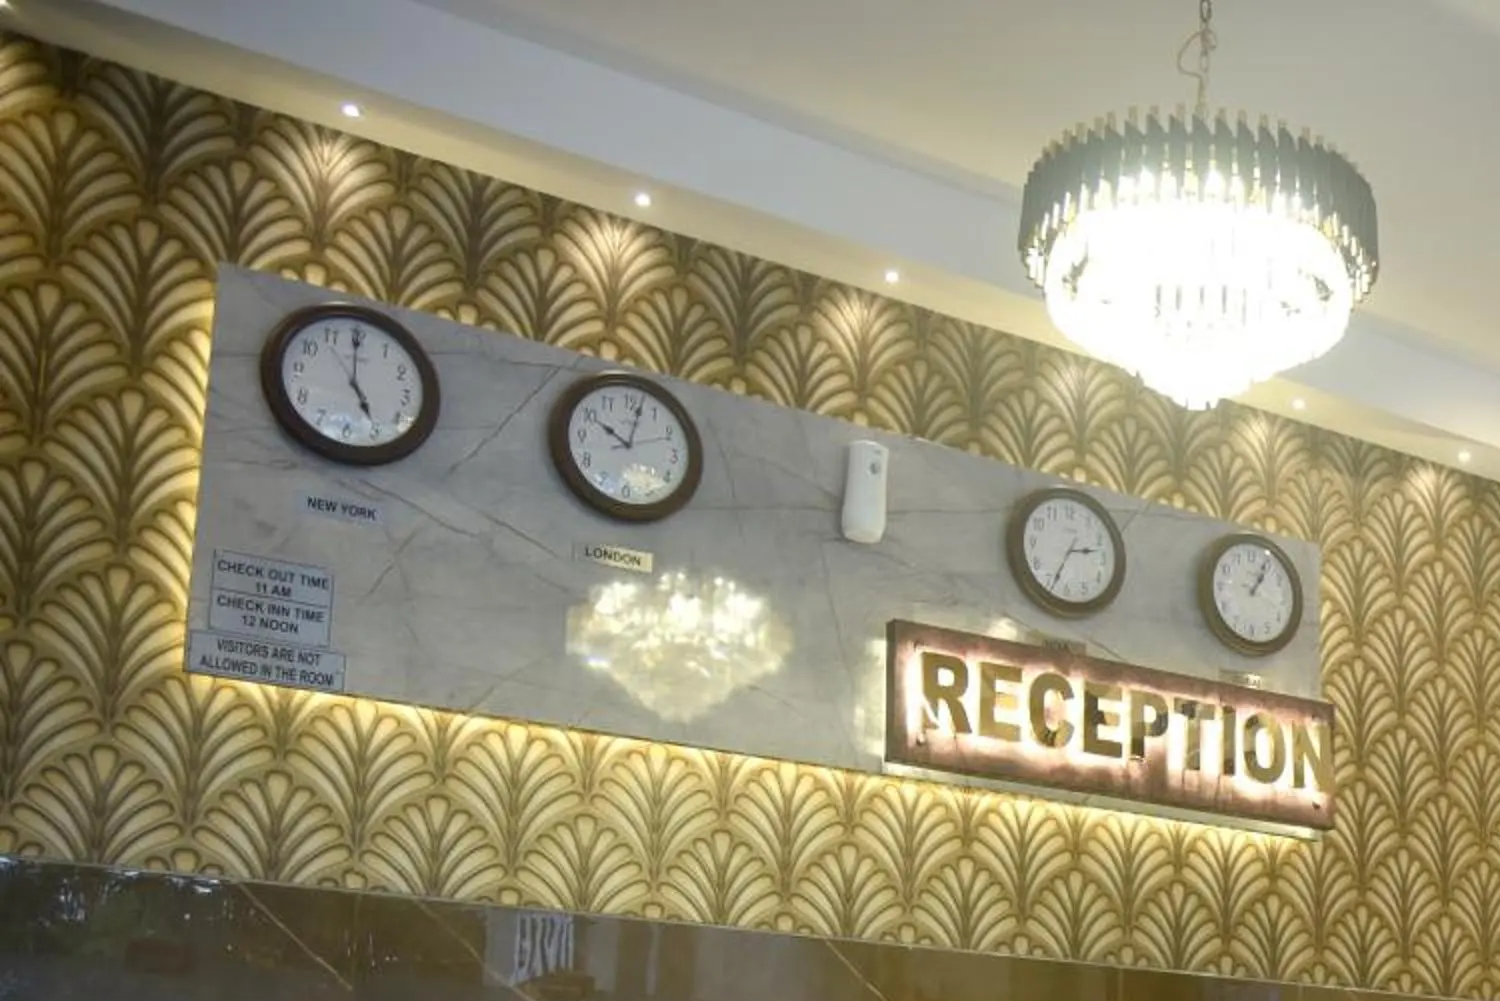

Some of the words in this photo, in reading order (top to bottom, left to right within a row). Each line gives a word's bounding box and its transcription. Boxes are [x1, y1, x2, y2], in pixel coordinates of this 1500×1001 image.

[306, 496, 337, 513] NEW
[341, 503, 377, 521] YORK
[585, 545, 641, 566] LONDON
[217, 558, 265, 578] CHECK
[268, 568, 296, 584] OUT
[301, 574, 329, 591] TIME
[256, 582, 267, 593] 11
[271, 584, 292, 598] AM
[217, 594, 264, 613] CHECK
[268, 603, 291, 617] INN
[295, 608, 325, 623] TIME
[242, 615, 256, 627] 12
[260, 618, 299, 634] NOON
[217, 639, 270, 657] VISITORS
[272, 649, 294, 662] ARE
[297, 652, 321, 666] NOT
[200, 655, 258, 675] ALLOWED
[260, 664, 271, 677] IN
[275, 667, 297, 681] THE
[301, 671, 334, 686] ROOM
[920, 650, 1329, 792] RECEPTION
